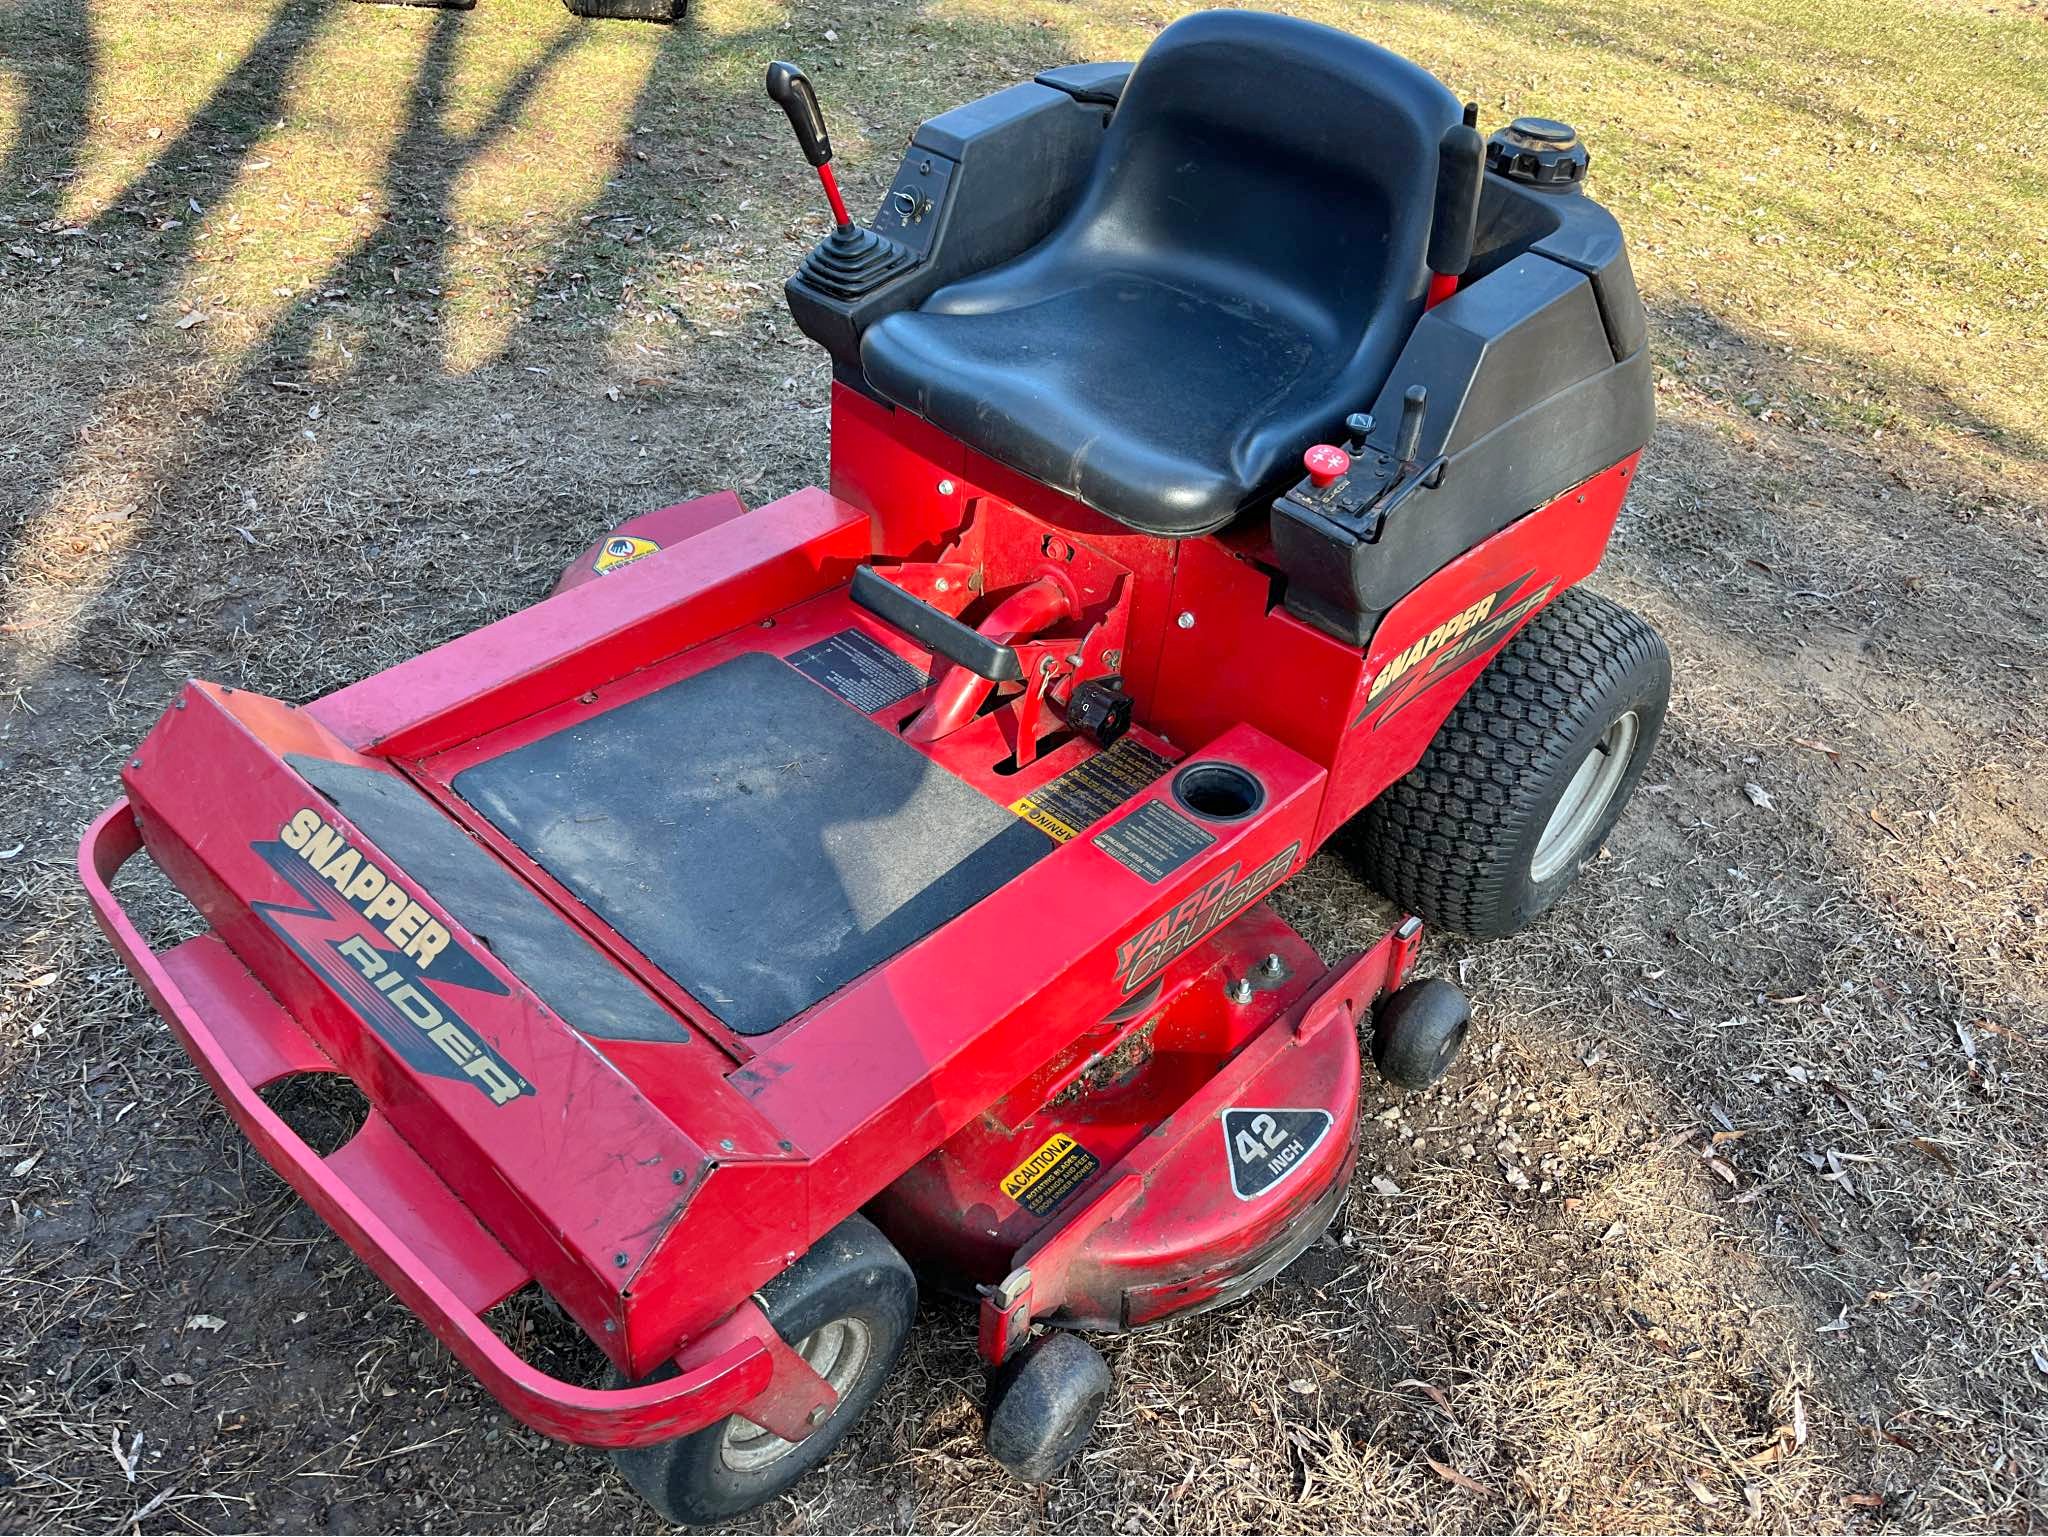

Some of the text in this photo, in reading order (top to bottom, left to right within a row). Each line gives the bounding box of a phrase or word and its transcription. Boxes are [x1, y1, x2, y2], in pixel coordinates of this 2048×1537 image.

[1368, 593, 1497, 702] SNAPPER
[1030, 806, 1074, 840] ARNING
[280, 807, 452, 970] SNAPPER
[1118, 868, 1236, 970] YARD
[1125, 842, 1299, 990] CRUISER
[1235, 1113, 1289, 1164] 42
[1267, 1139, 1305, 1175] INCH
[1014, 1143, 1062, 1186] CAUTION
[1026, 1154, 1078, 1200] ROTATING BLADES
[1044, 1177, 1065, 1197] HANDS
[1063, 1167, 1077, 1181] AND
[1075, 1153, 1090, 1170] FEET
[1053, 1179, 1074, 1200] UNDER
